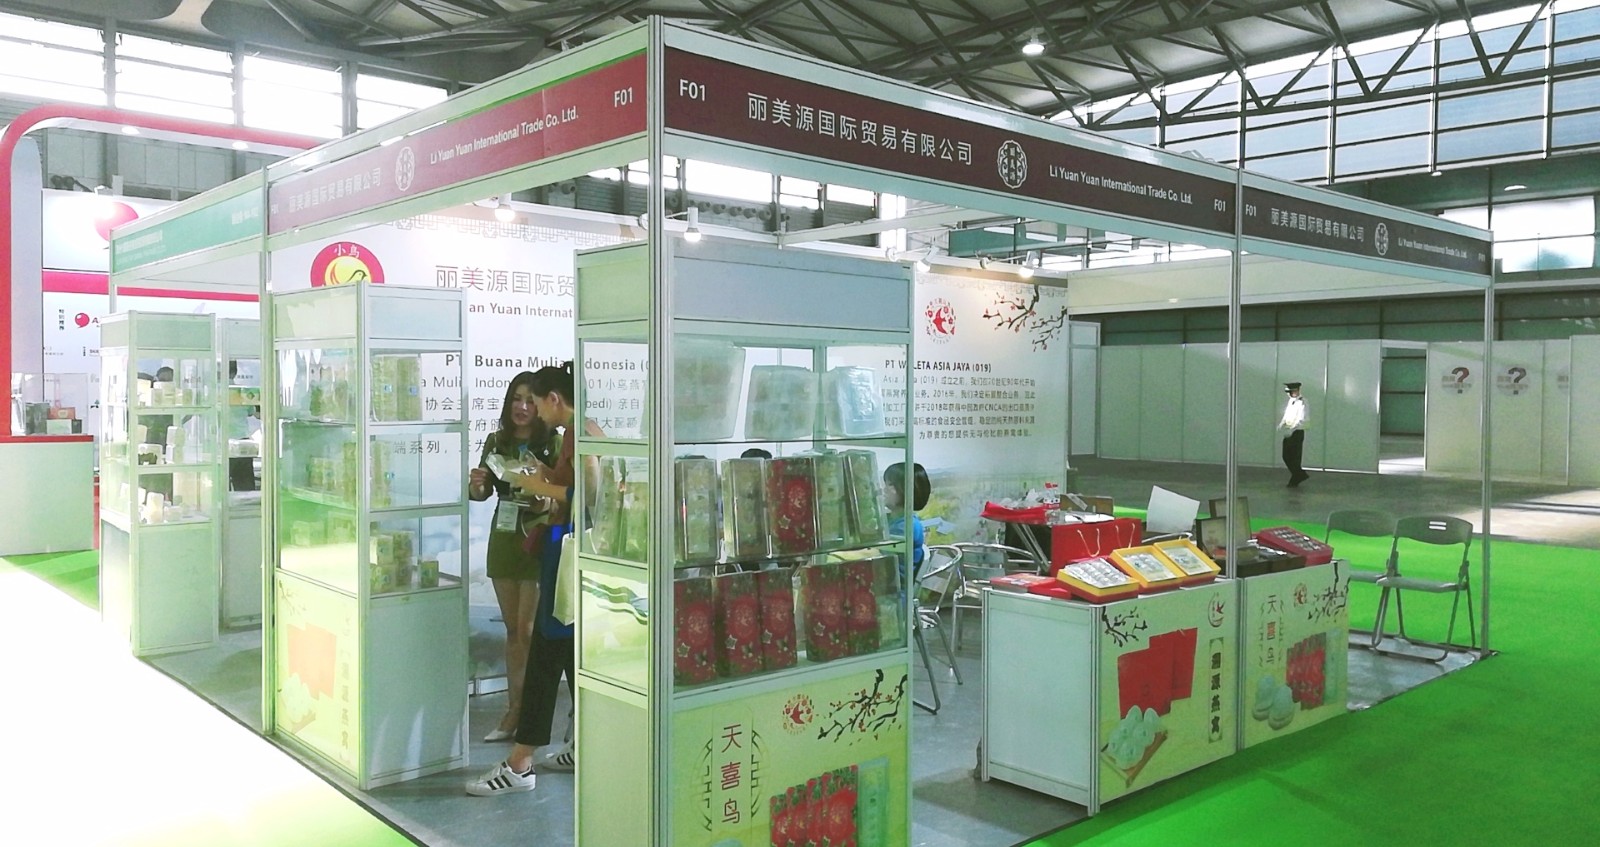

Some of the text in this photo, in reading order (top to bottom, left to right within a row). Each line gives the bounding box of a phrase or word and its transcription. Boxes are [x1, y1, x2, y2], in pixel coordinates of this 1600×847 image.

[614, 87, 634, 107] F01
[680, 78, 706, 101] F01
[430, 106, 579, 164] Li Yuan Yuan International Trade Co. Ltd.
[747, 92, 973, 166] 丽美源国际贸易有限公司
[288, 167, 381, 213] 丽美源国际贸易有限公司
[1049, 165, 1058, 177] Li
[1059, 167, 1079, 183] Yuan
[1080, 171, 1100, 186] Yuan
[1101, 176, 1147, 196] International
[1148, 185, 1167, 200] Trade
[1180, 192, 1193, 205] Ltd.
[1214, 199, 1226, 212] F01
[1245, 204, 1257, 216] F01
[1271, 207, 1365, 242] 丽美源国际贸易有限公司
[334, 243, 360, 259] 小鸟
[490, 302, 522, 316] Yuan
[474, 355, 523, 367] Buana
[885, 360, 895, 369] PT
[932, 361, 951, 371] ASIA
[952, 362, 970, 372] JAYA
[972, 363, 992, 373] (019)
[1266, 594, 1277, 664] 天喜鸟
[720, 724, 742, 824] 天喜鸟
